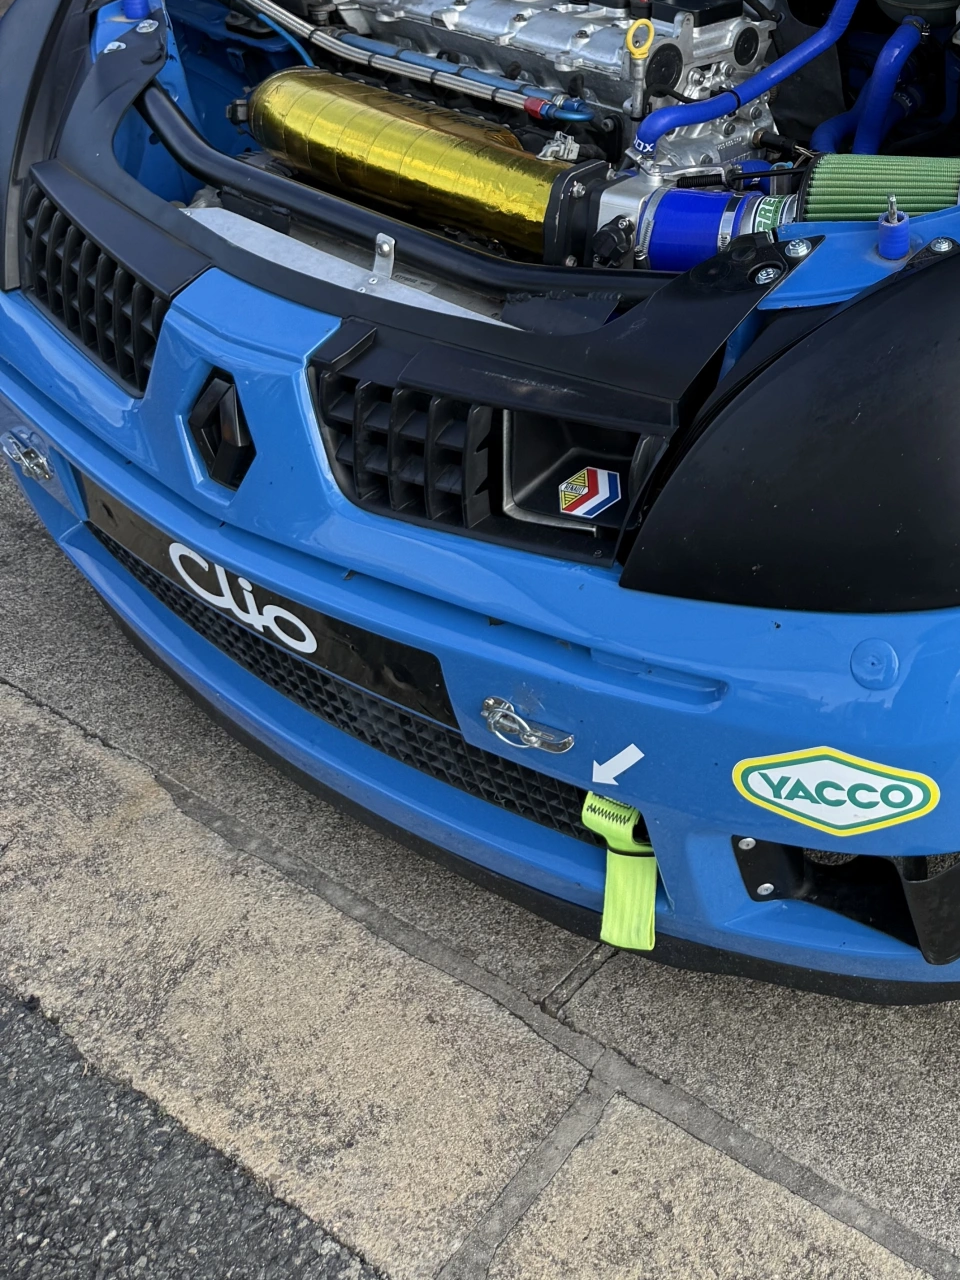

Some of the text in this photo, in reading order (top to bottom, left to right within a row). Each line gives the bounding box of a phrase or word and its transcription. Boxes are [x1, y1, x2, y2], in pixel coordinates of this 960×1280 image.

[564, 483, 585, 494] RENAULT
[168, 542, 318, 654] Clio
[757, 771, 914, 810] YACCO
